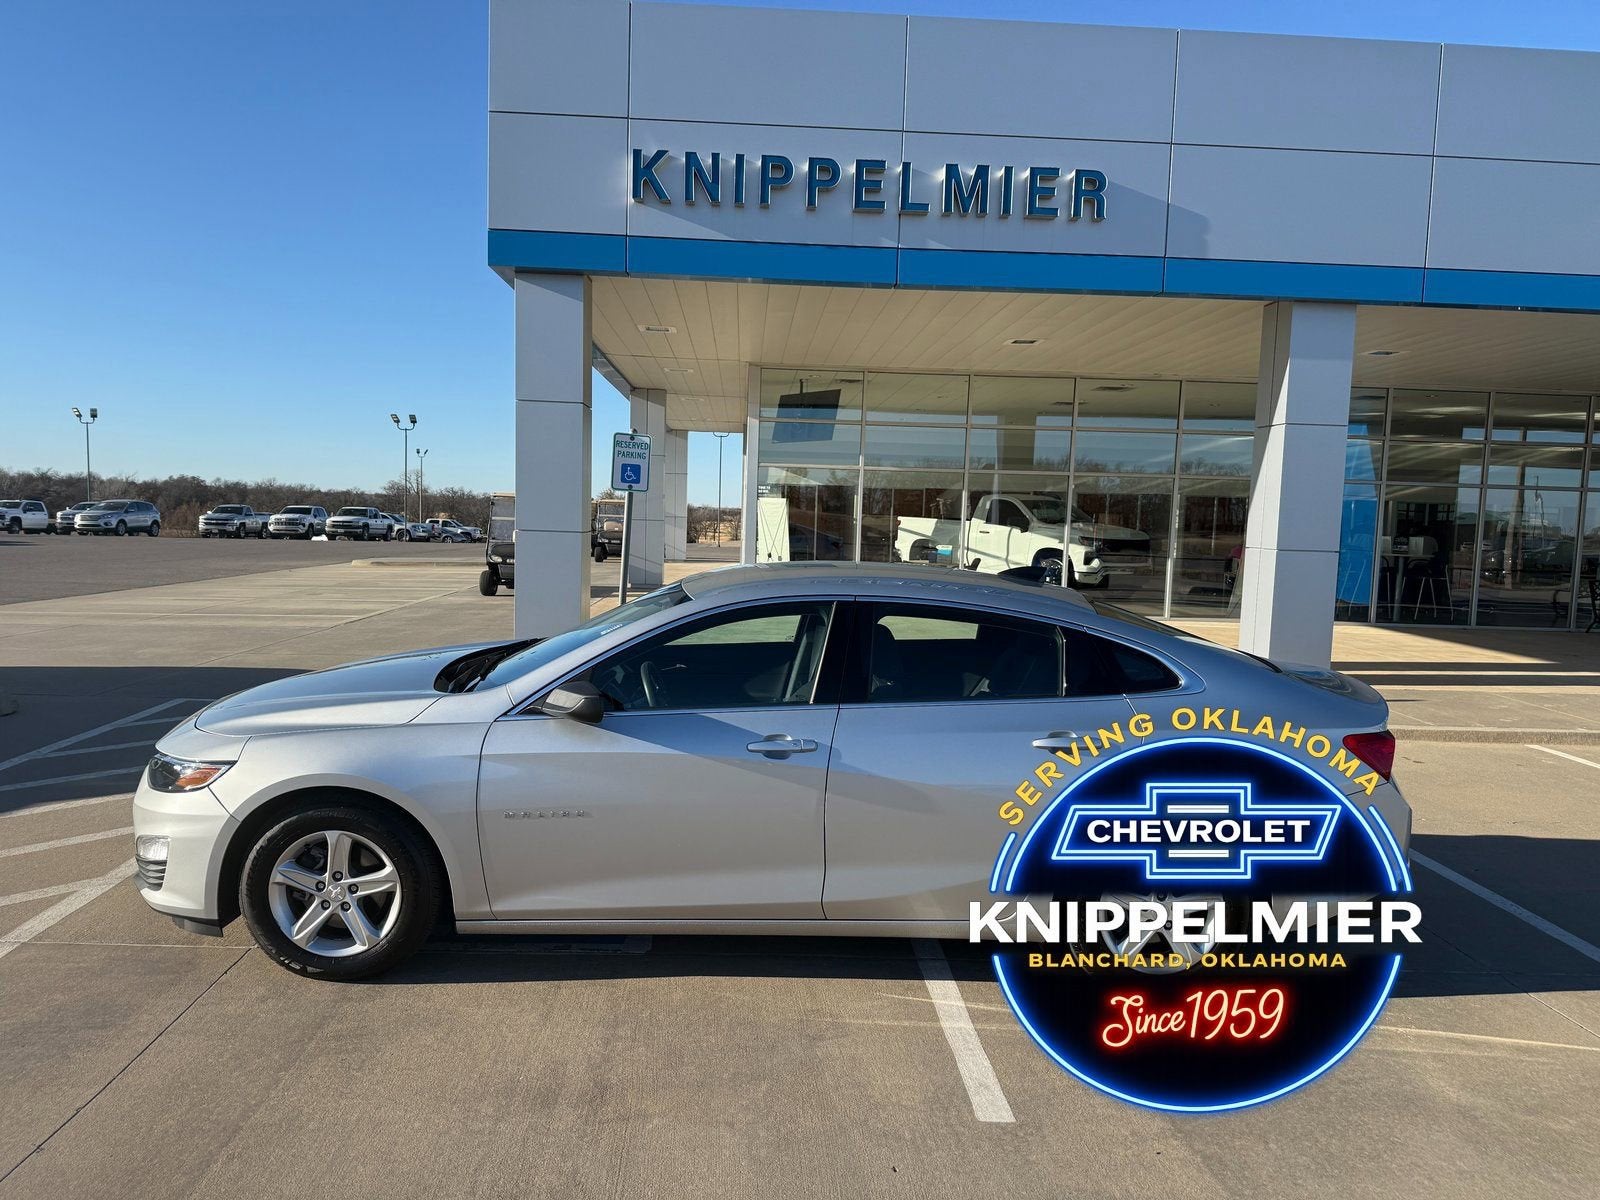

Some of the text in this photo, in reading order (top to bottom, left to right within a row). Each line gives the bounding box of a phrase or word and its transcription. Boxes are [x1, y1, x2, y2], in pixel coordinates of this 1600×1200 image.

[632, 149, 1107, 221] KNIPPELMIER
[615, 440, 649, 450] RESERVED
[617, 450, 647, 460] PARKING
